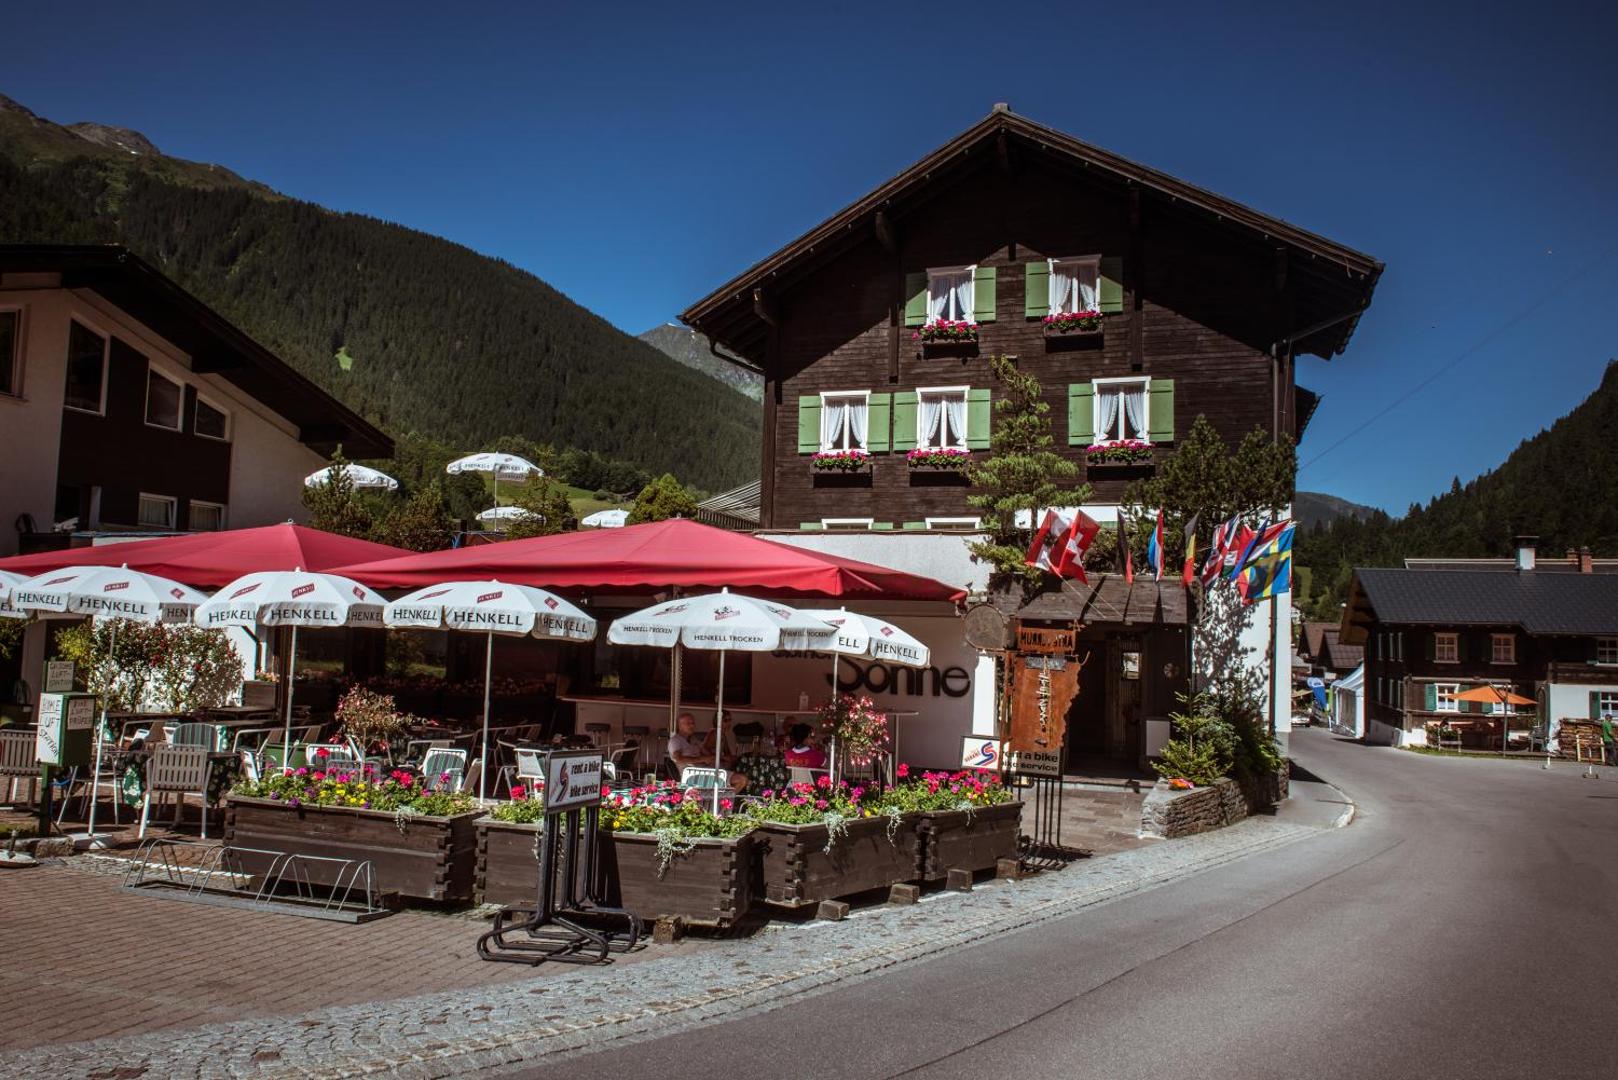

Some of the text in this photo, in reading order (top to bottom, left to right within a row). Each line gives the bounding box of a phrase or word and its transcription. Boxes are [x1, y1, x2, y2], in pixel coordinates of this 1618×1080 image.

[17, 592, 62, 605] HENKELL
[80, 597, 147, 614] HENKELL
[167, 608, 193, 617] HEN
[271, 609, 337, 620] HENKELL
[352, 611, 382, 621] HENKE
[393, 609, 437, 621] HENKELL
[454, 611, 522, 626] HENKELL
[543, 617, 588, 633] HENKELL
[729, 635, 763, 643] TROCKEN
[838, 636, 859, 648] ELL
[876, 642, 920, 660] HENKELL
[827, 656, 971, 697] Sonne
[1034, 751, 1058, 762] bike
[1020, 762, 1058, 772] service
